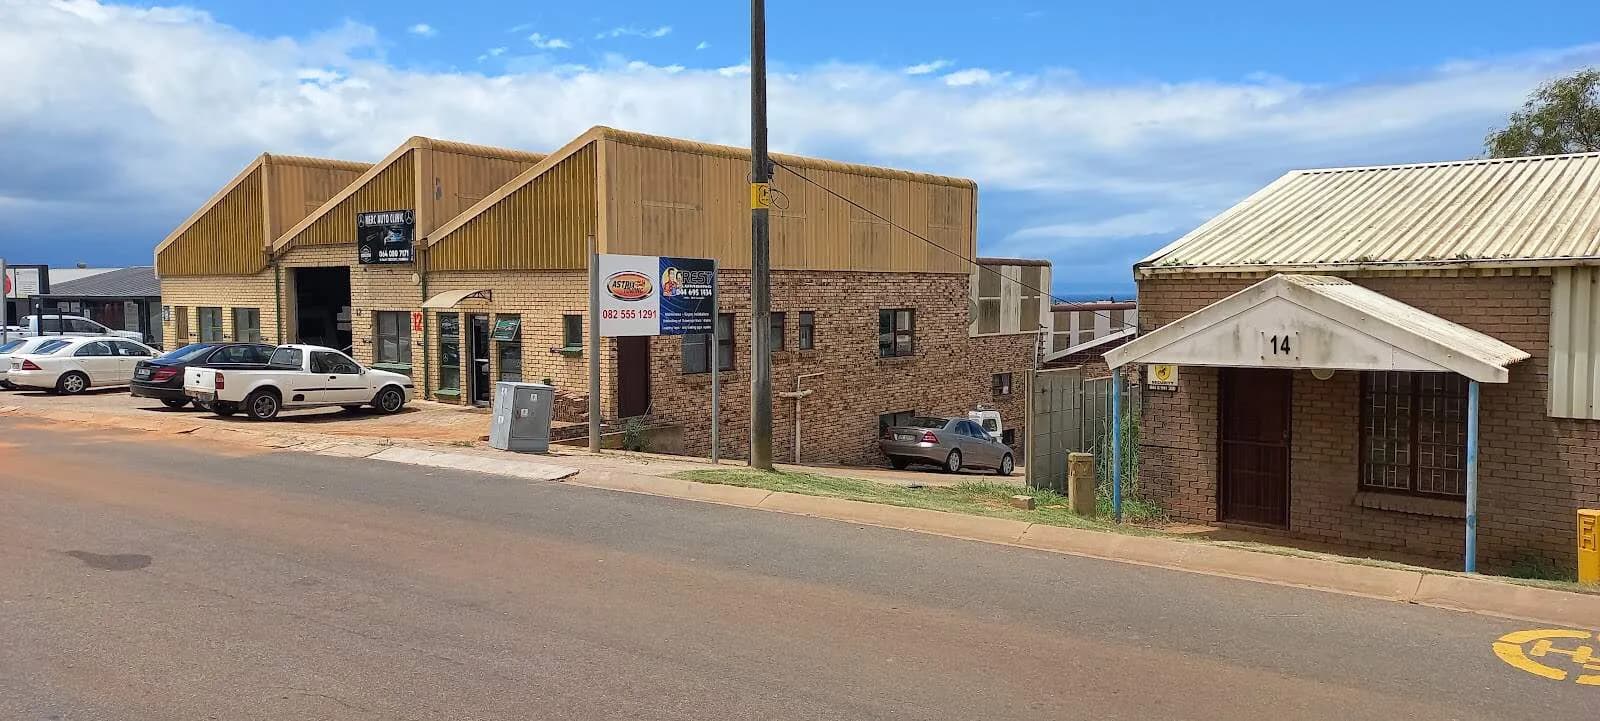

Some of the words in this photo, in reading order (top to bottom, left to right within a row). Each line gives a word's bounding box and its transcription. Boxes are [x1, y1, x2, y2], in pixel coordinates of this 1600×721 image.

[365, 214, 377, 225] MERC
[378, 213, 390, 224] AUTO
[390, 212, 405, 224] CLINIC
[413, 312, 423, 331] 12
[602, 309, 618, 319] 082
[620, 309, 636, 319] 555
[638, 309, 657, 319] 1291
[1270, 335, 1291, 355] 14
